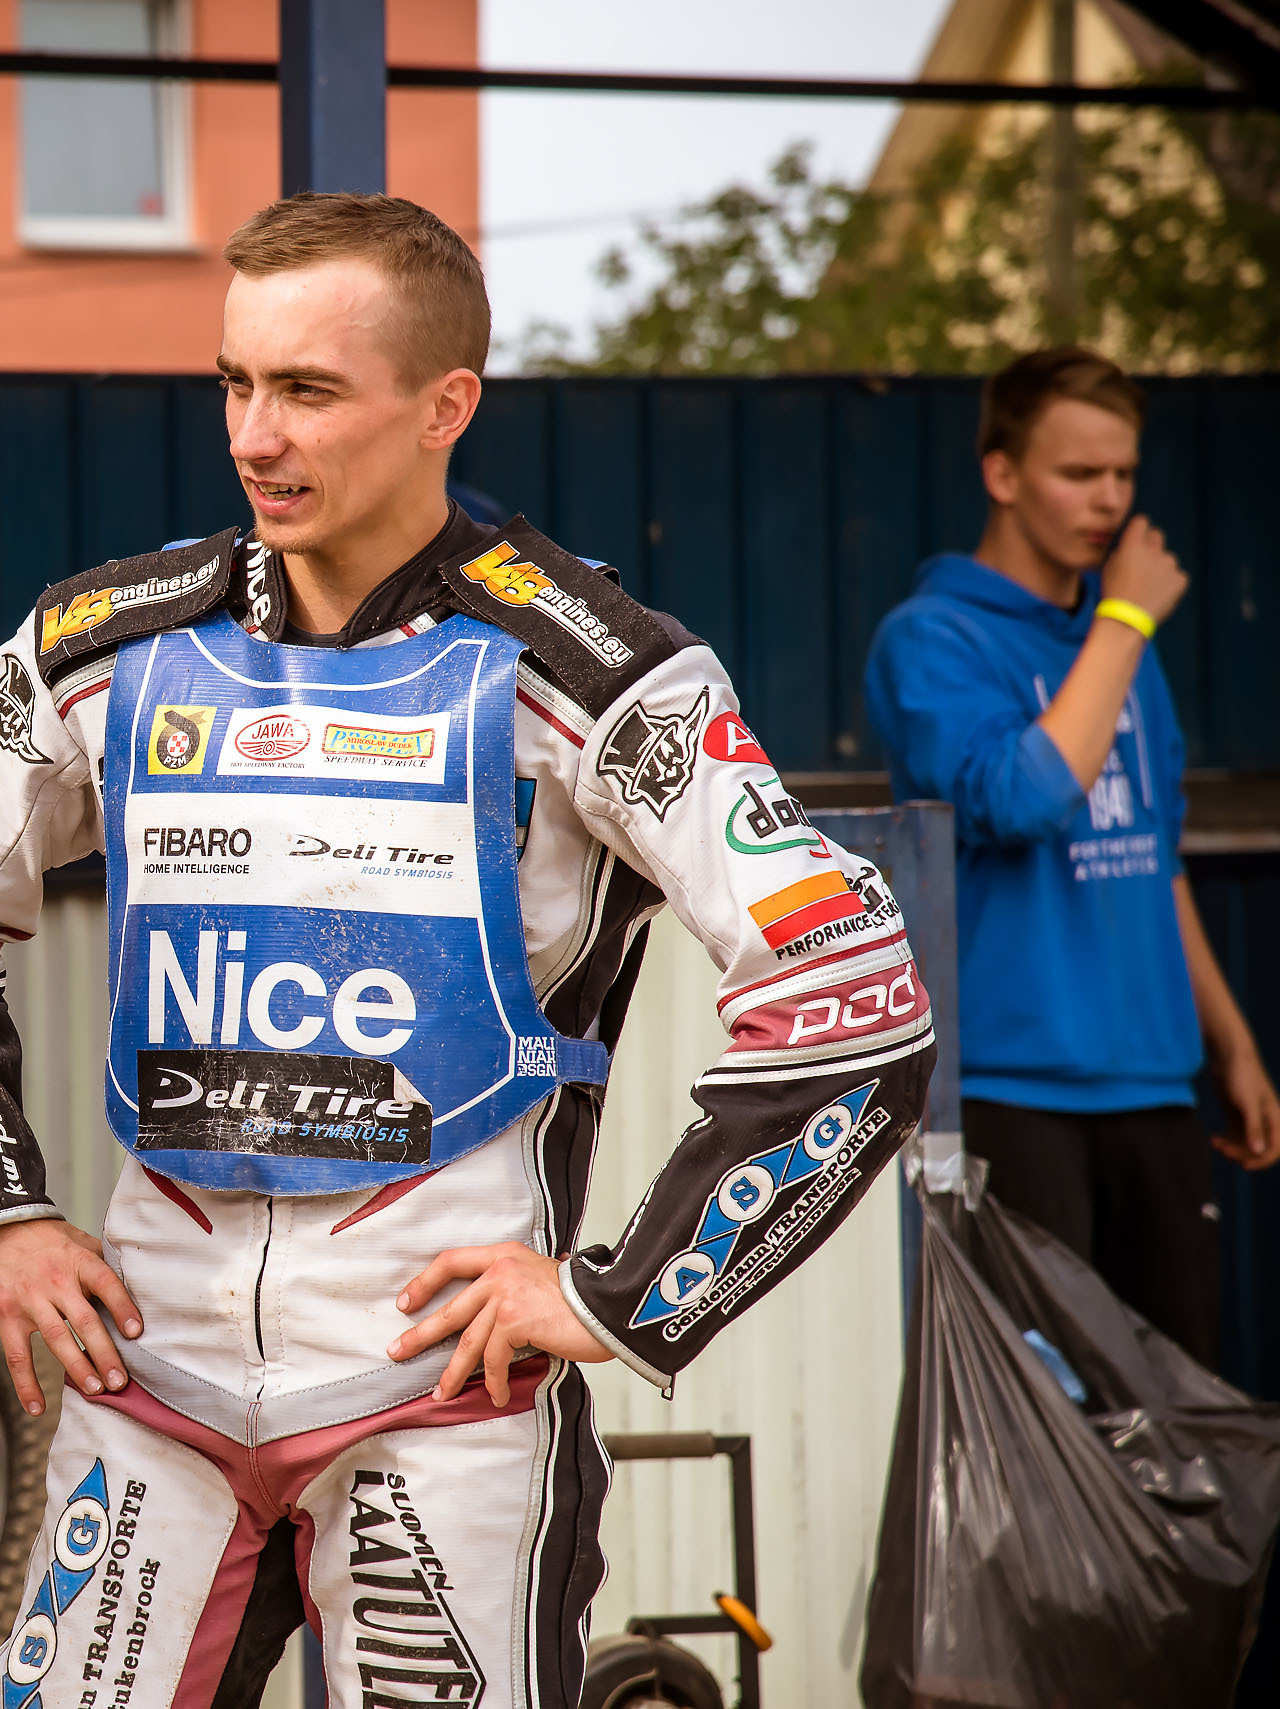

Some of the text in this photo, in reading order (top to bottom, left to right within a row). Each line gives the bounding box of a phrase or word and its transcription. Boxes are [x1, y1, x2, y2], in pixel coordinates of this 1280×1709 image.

[251, 722, 294, 739] JAWA
[163, 755, 187, 768] PZM
[324, 755, 428, 768] SPEEDWAY SERVICE
[143, 827, 252, 858] FIBARO
[387, 846, 455, 866] Tire
[143, 863, 250, 875] HOME INTELLIGENCE
[360, 866, 453, 879] ROAD SYMBIOSIS
[775, 914, 872, 960] PERFORMANCE
[148, 930, 417, 1056] Nice
[517, 1036, 555, 1050] MALI
[517, 1063, 557, 1077] DSGN
[151, 1066, 414, 1119] Deli Tire
[239, 1117, 408, 1143] ROAD SYMBIOSIS
[768, 1110, 889, 1242] TRANSPORTE
[386, 1472, 454, 1591] SUOMEN
[82, 1479, 147, 1680] TRANSPORTE
